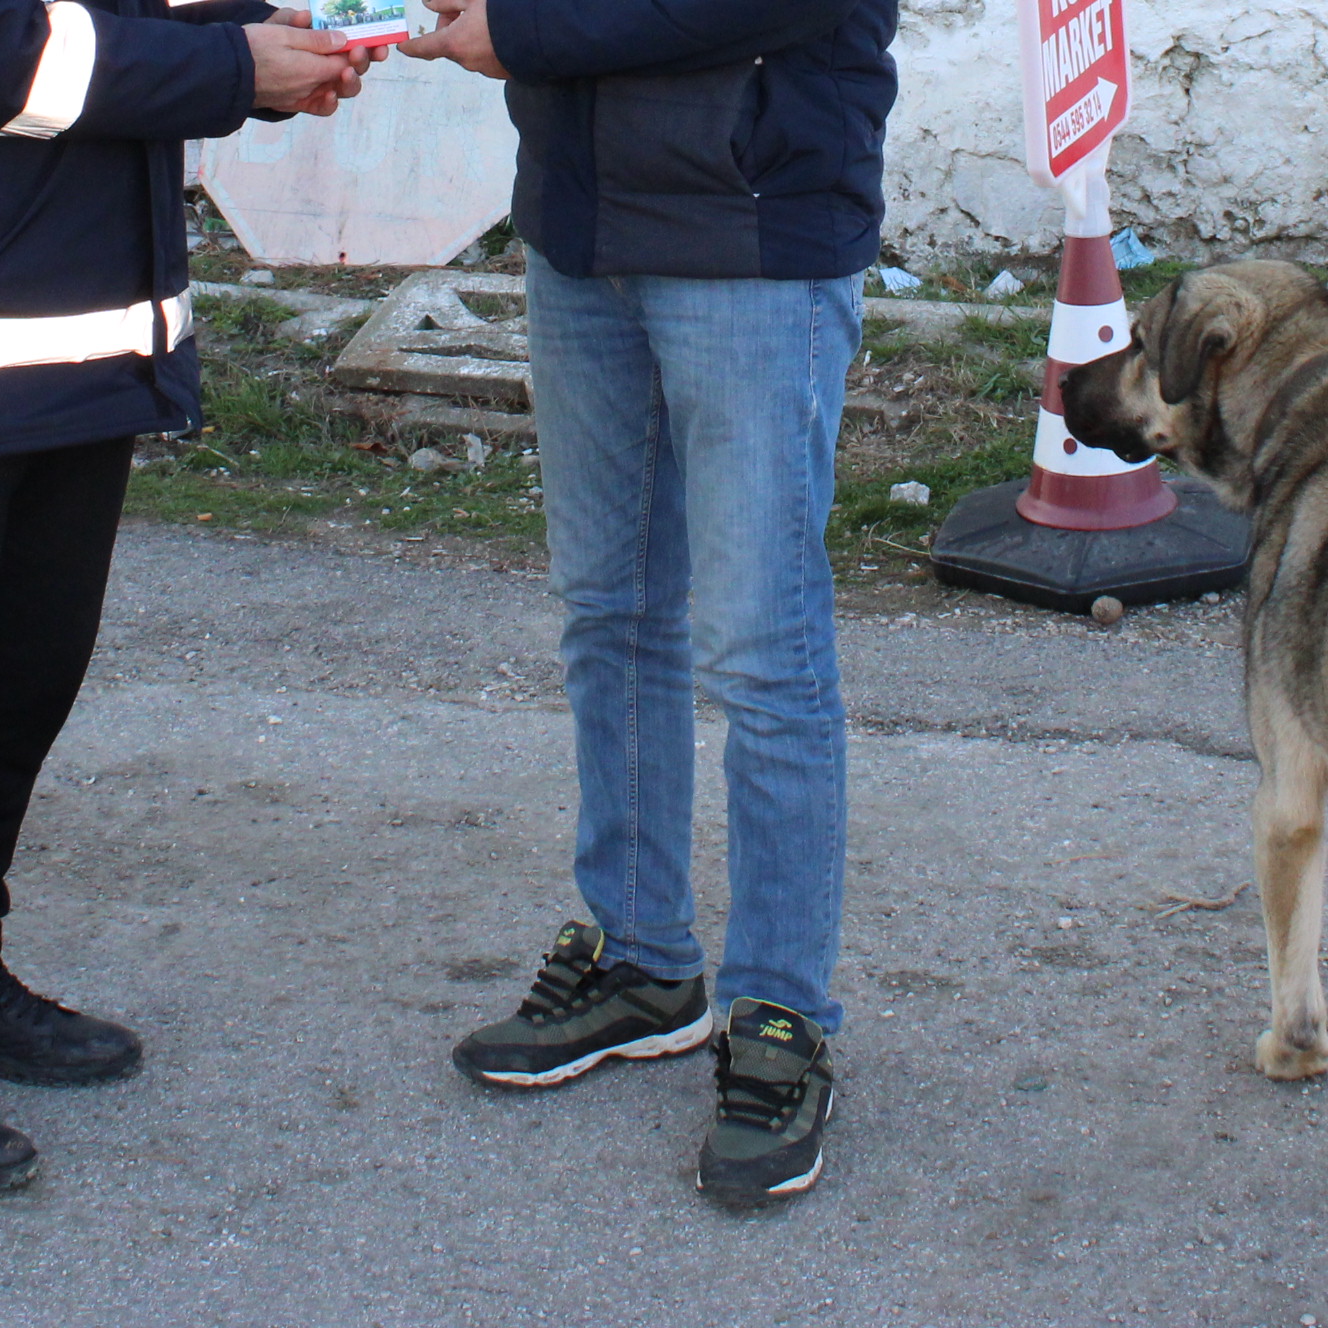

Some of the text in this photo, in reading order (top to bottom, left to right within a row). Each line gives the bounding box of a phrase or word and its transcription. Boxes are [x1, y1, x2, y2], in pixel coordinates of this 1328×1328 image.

[1052, 90, 1103, 151] 0544 595 32 14
[759, 1024, 794, 1042] JUMP
